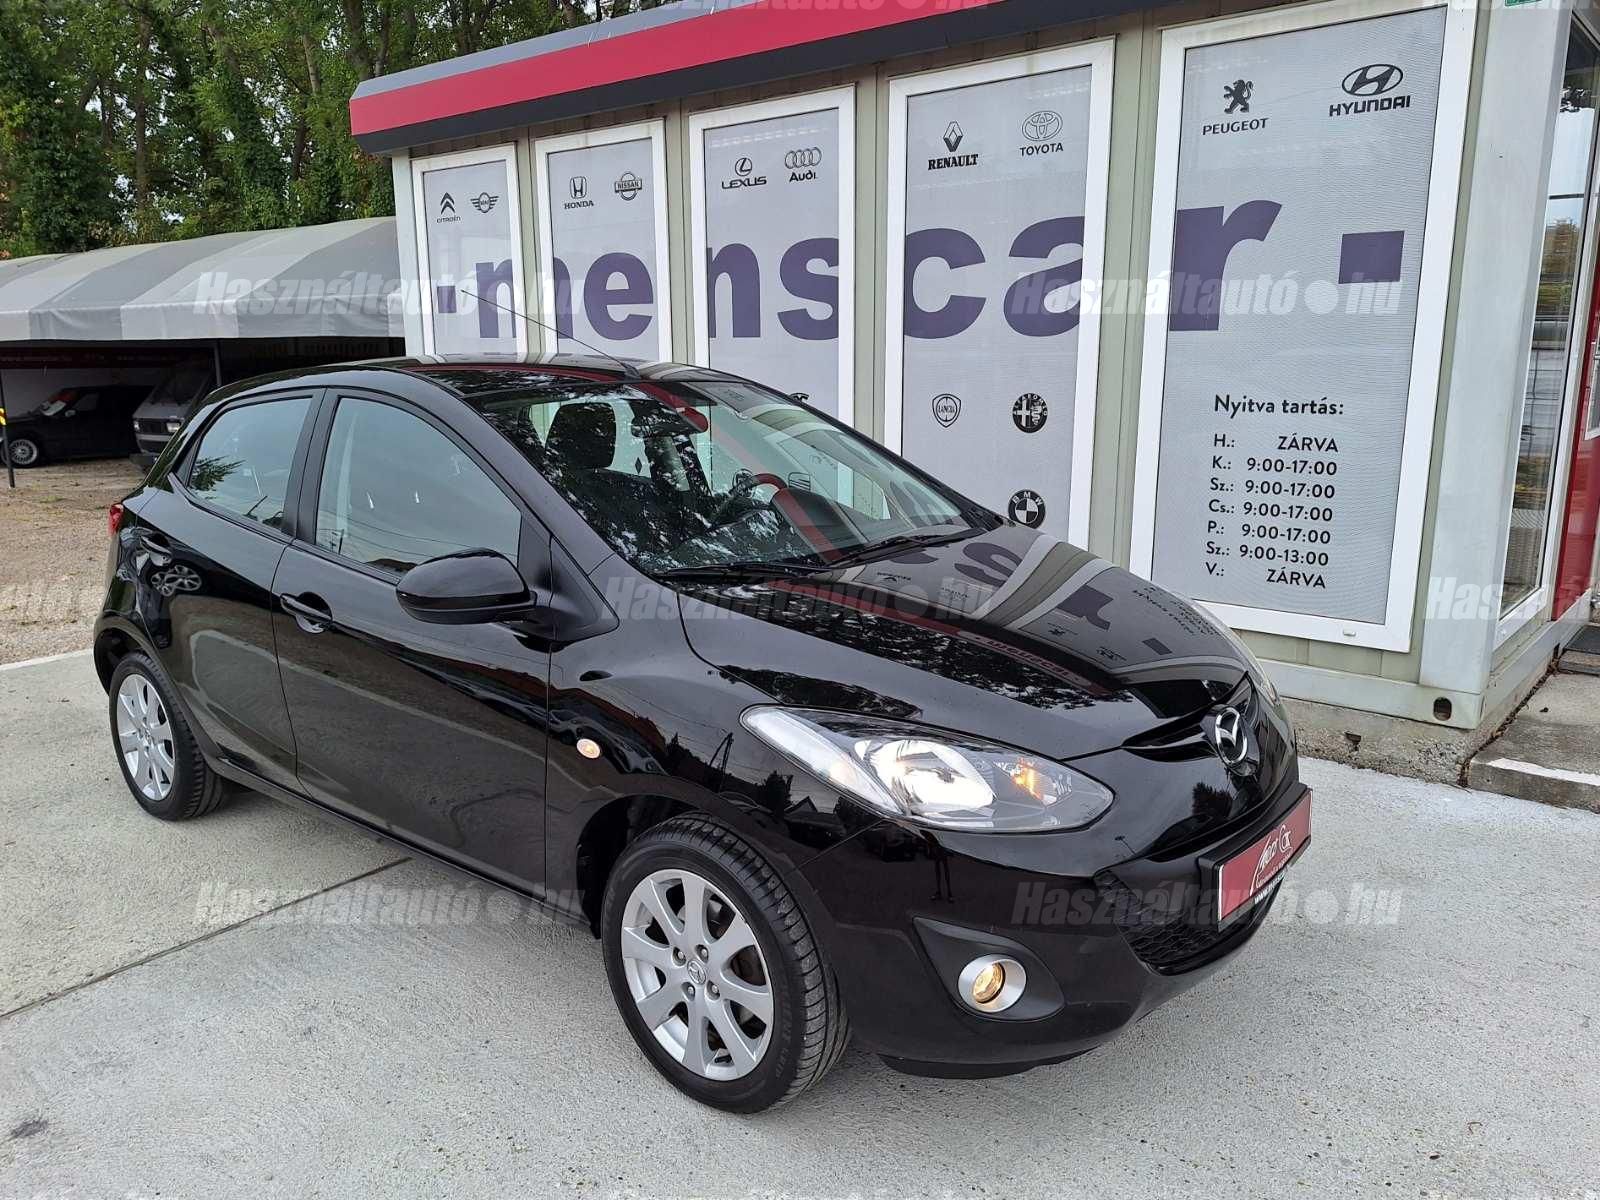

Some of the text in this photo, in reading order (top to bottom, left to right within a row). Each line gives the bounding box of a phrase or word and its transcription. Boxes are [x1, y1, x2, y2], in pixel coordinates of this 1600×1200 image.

[1329, 95, 1411, 117] HYUNDAI
[1202, 118, 1270, 135] PEUGEOT
[1019, 143, 1064, 157] TOYOTA
[927, 153, 979, 171] RENAULT
[617, 180, 640, 190] NISSAN
[721, 176, 767, 189] LEXUS
[789, 170, 817, 183] Audi
[564, 200, 595, 210] HONDA
[1214, 394, 1344, 418] Nyitva tartás:
[1213, 432, 1339, 452] H.: ZÁRVA
[1212, 455, 1338, 476] K.: 9:00-17:00
[1210, 477, 1335, 499] Sz.: 9:00-17:00
[1208, 499, 1333, 522] Cs.: 9:00-17:00
[1207, 520, 1331, 544] P.: 9:00-17:00
[1206, 541, 1329, 566] Sz.: 9:00-13:00
[1205, 561, 1326, 589] V.: ZÁRVA
